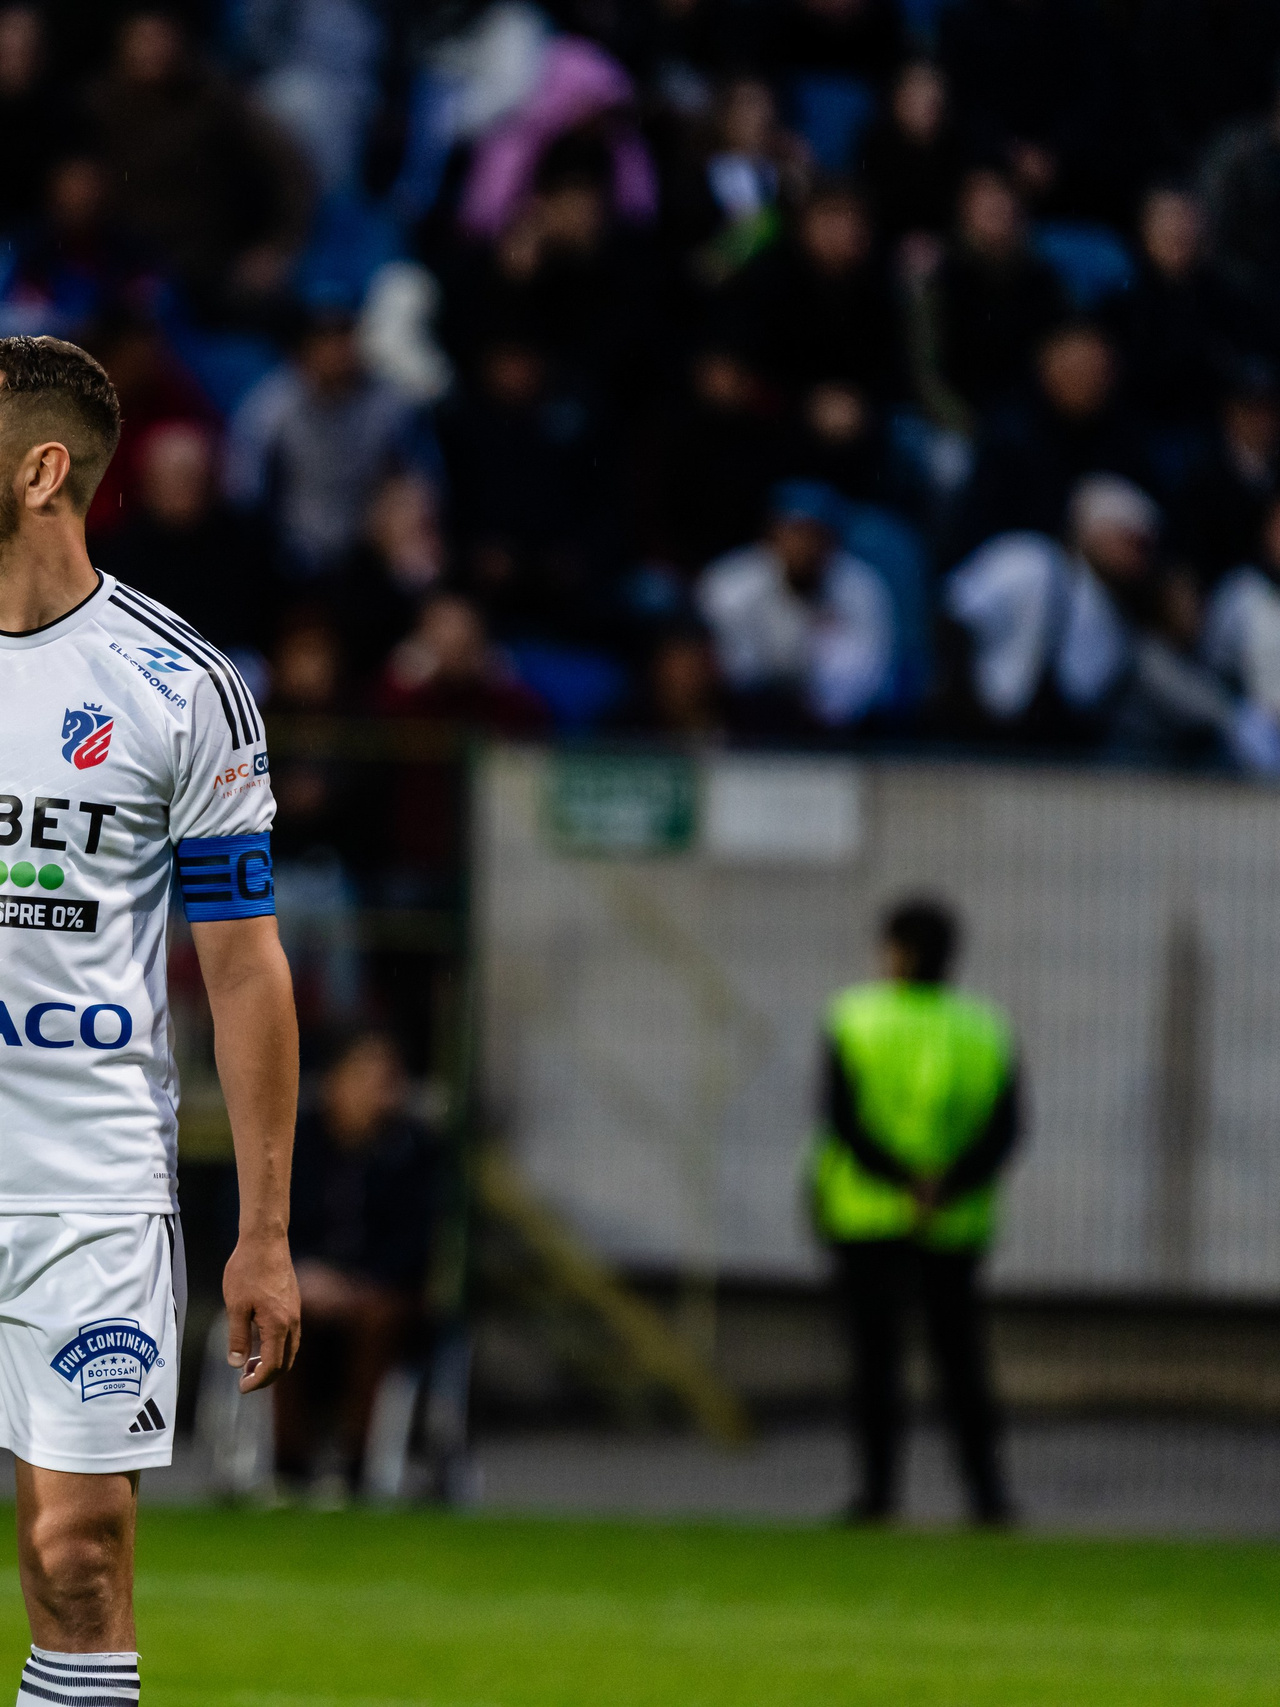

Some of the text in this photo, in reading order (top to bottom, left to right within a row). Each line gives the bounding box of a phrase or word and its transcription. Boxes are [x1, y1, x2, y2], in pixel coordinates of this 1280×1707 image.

[109, 642, 188, 710] ELECTROALFA
[51, 906, 85, 929] 0%
[58, 1331, 156, 1374] FIVE CONTINENTS
[88, 1366, 138, 1378] BOTOSANI
[103, 1383, 126, 1391] GROUP
